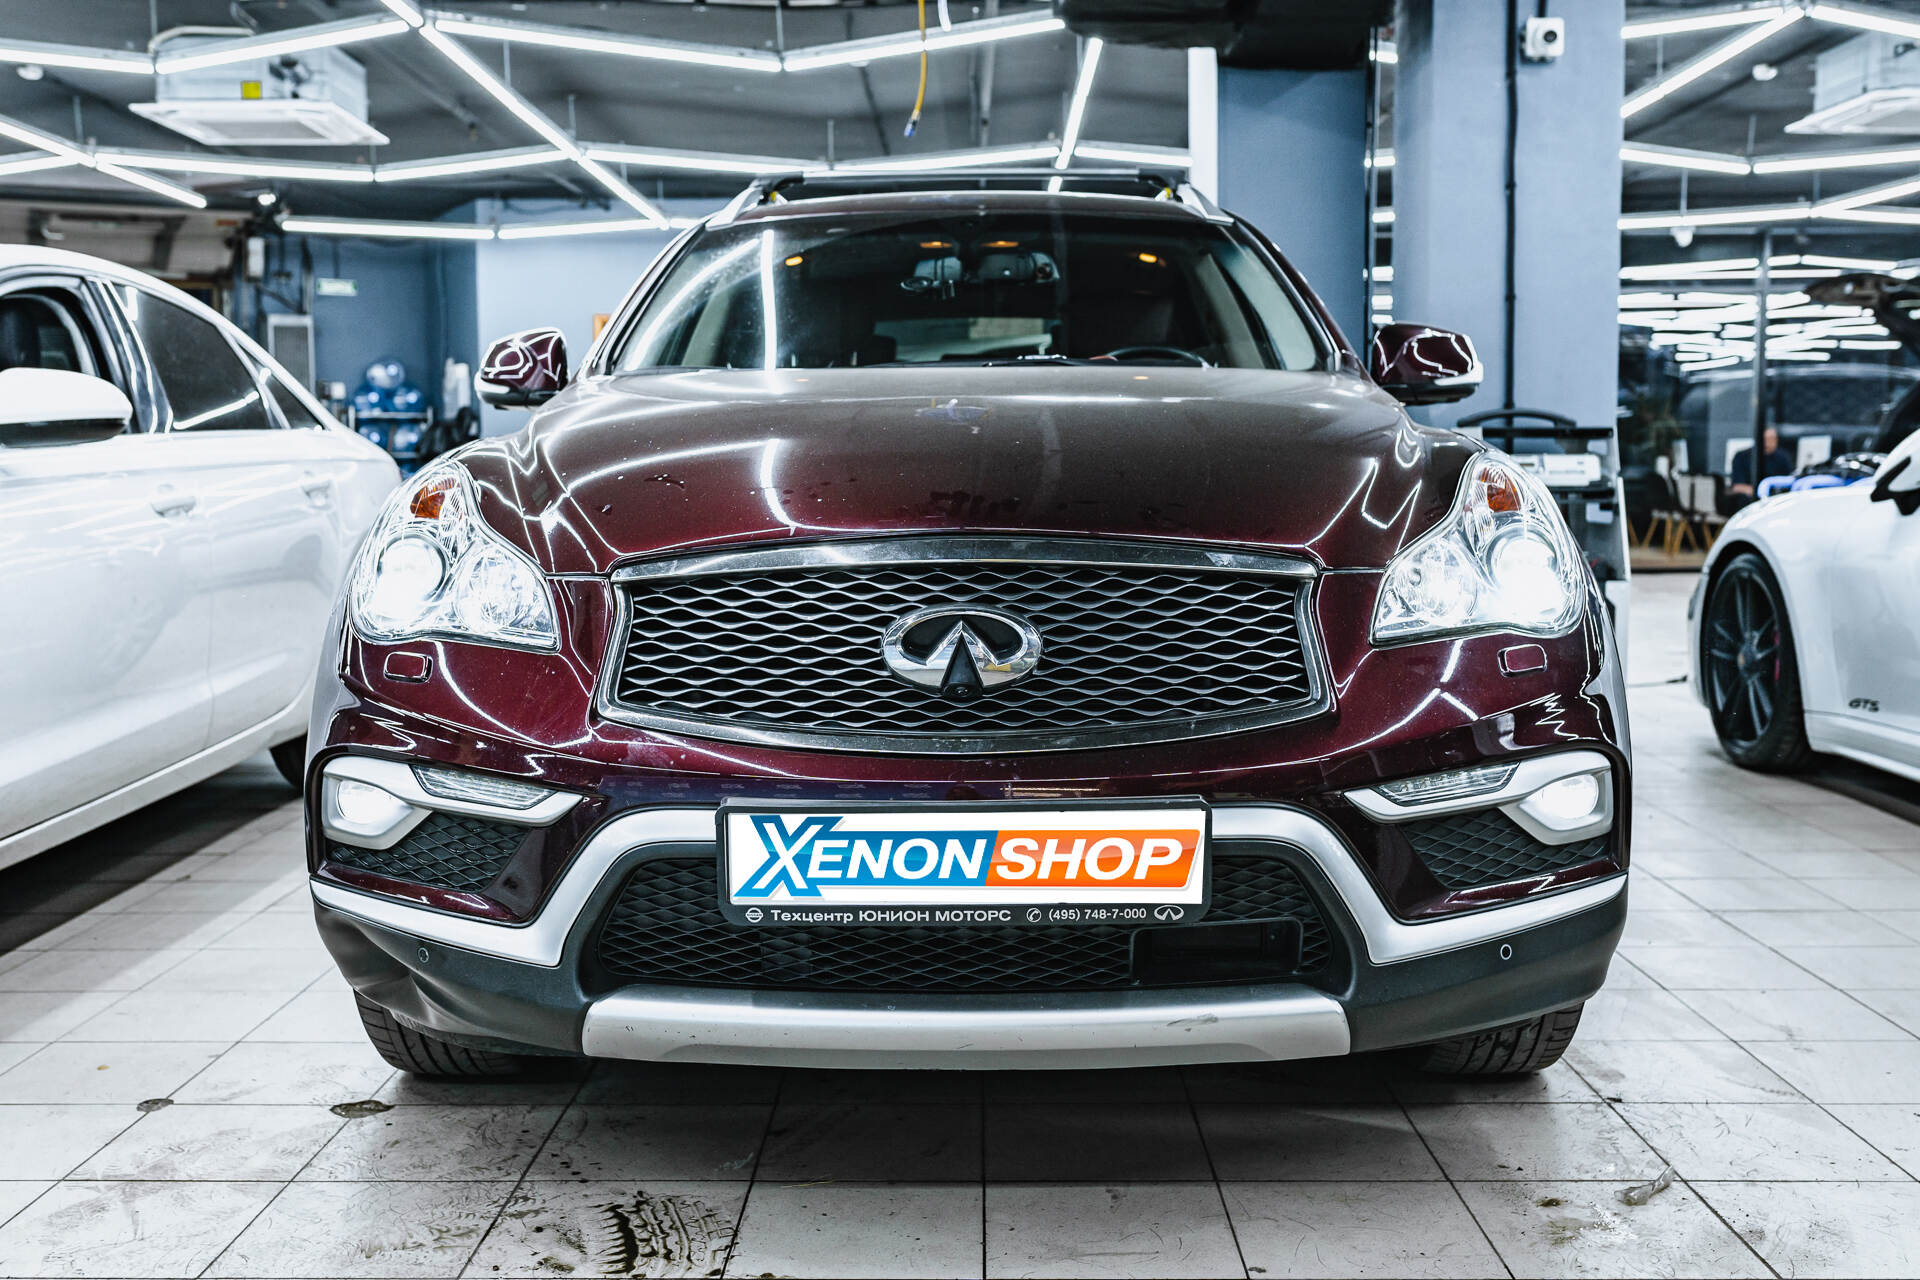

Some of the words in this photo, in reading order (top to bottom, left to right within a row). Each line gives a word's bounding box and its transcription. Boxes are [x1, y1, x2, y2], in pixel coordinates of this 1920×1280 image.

[1848, 698, 1880, 712] GTS
[736, 815, 988, 896] XENON
[996, 837, 1184, 881] SHOP
[770, 909, 854, 924] Техцентр
[858, 910, 930, 922] ЮНИОН
[935, 909, 1012, 922] МОТОРС
[1048, 908, 1081, 922] (495)
[1084, 907, 1147, 920] 748-7-000
